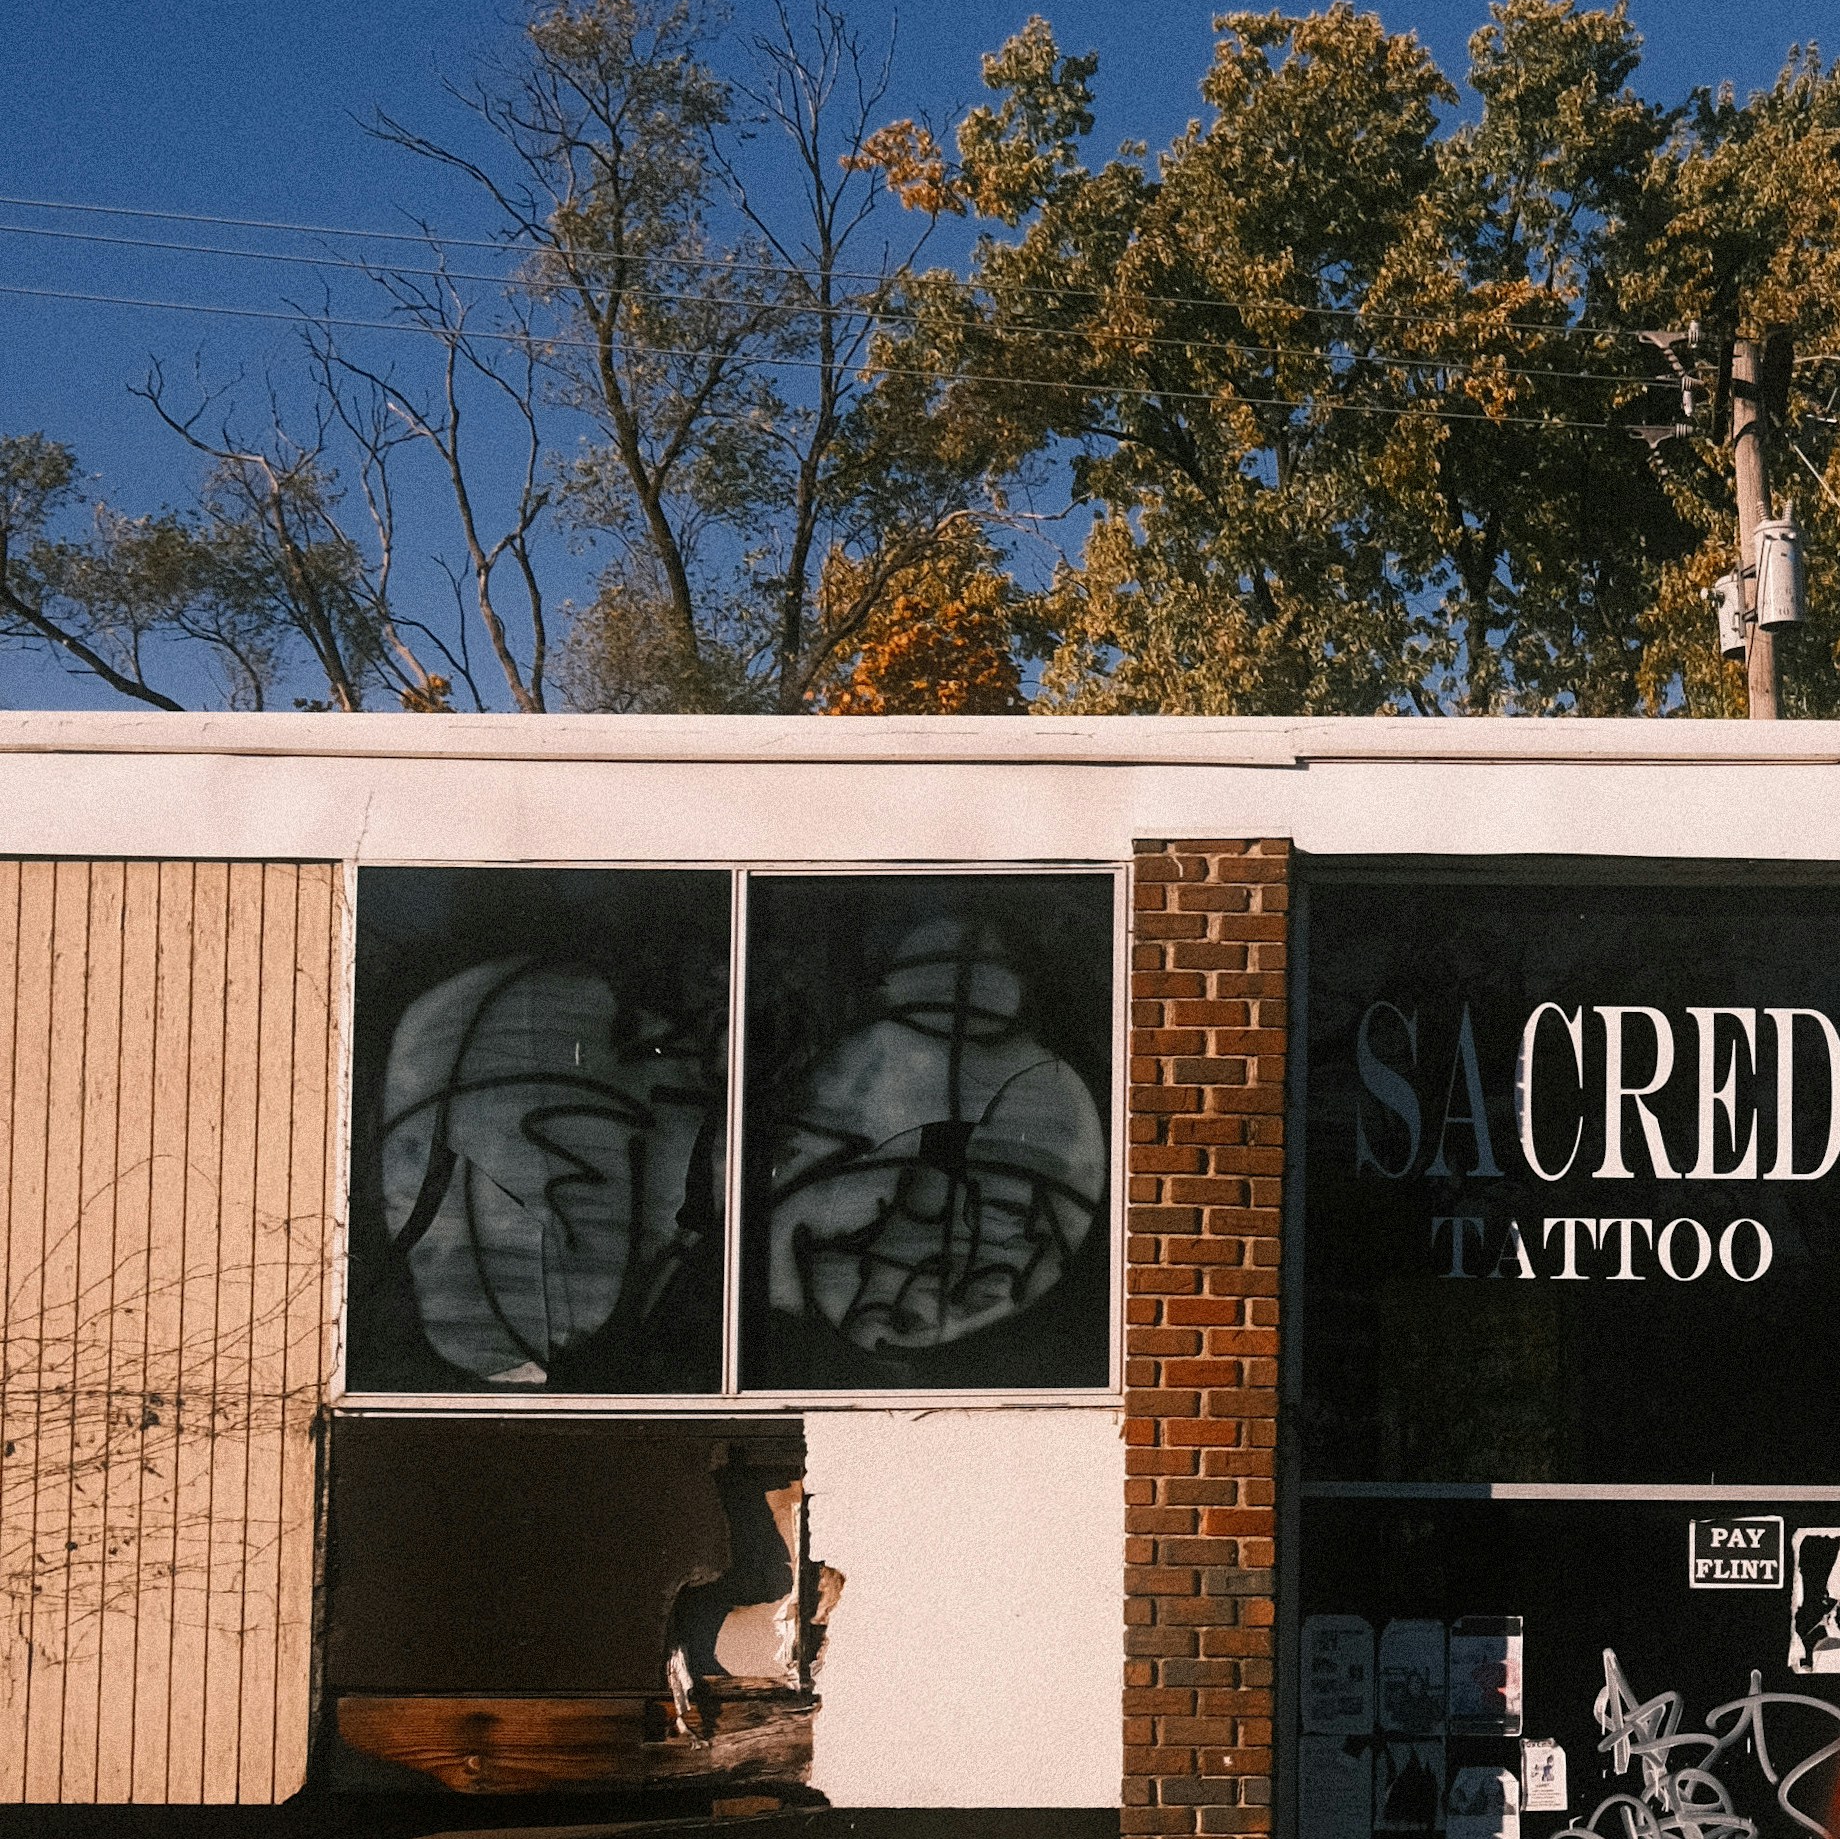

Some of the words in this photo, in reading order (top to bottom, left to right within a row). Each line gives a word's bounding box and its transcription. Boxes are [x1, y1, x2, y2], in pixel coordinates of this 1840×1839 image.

[1431, 1217, 1773, 1281] TATTOO
[1710, 1528, 1766, 1548] PAY
[1695, 1559, 1778, 1579] FLINT
